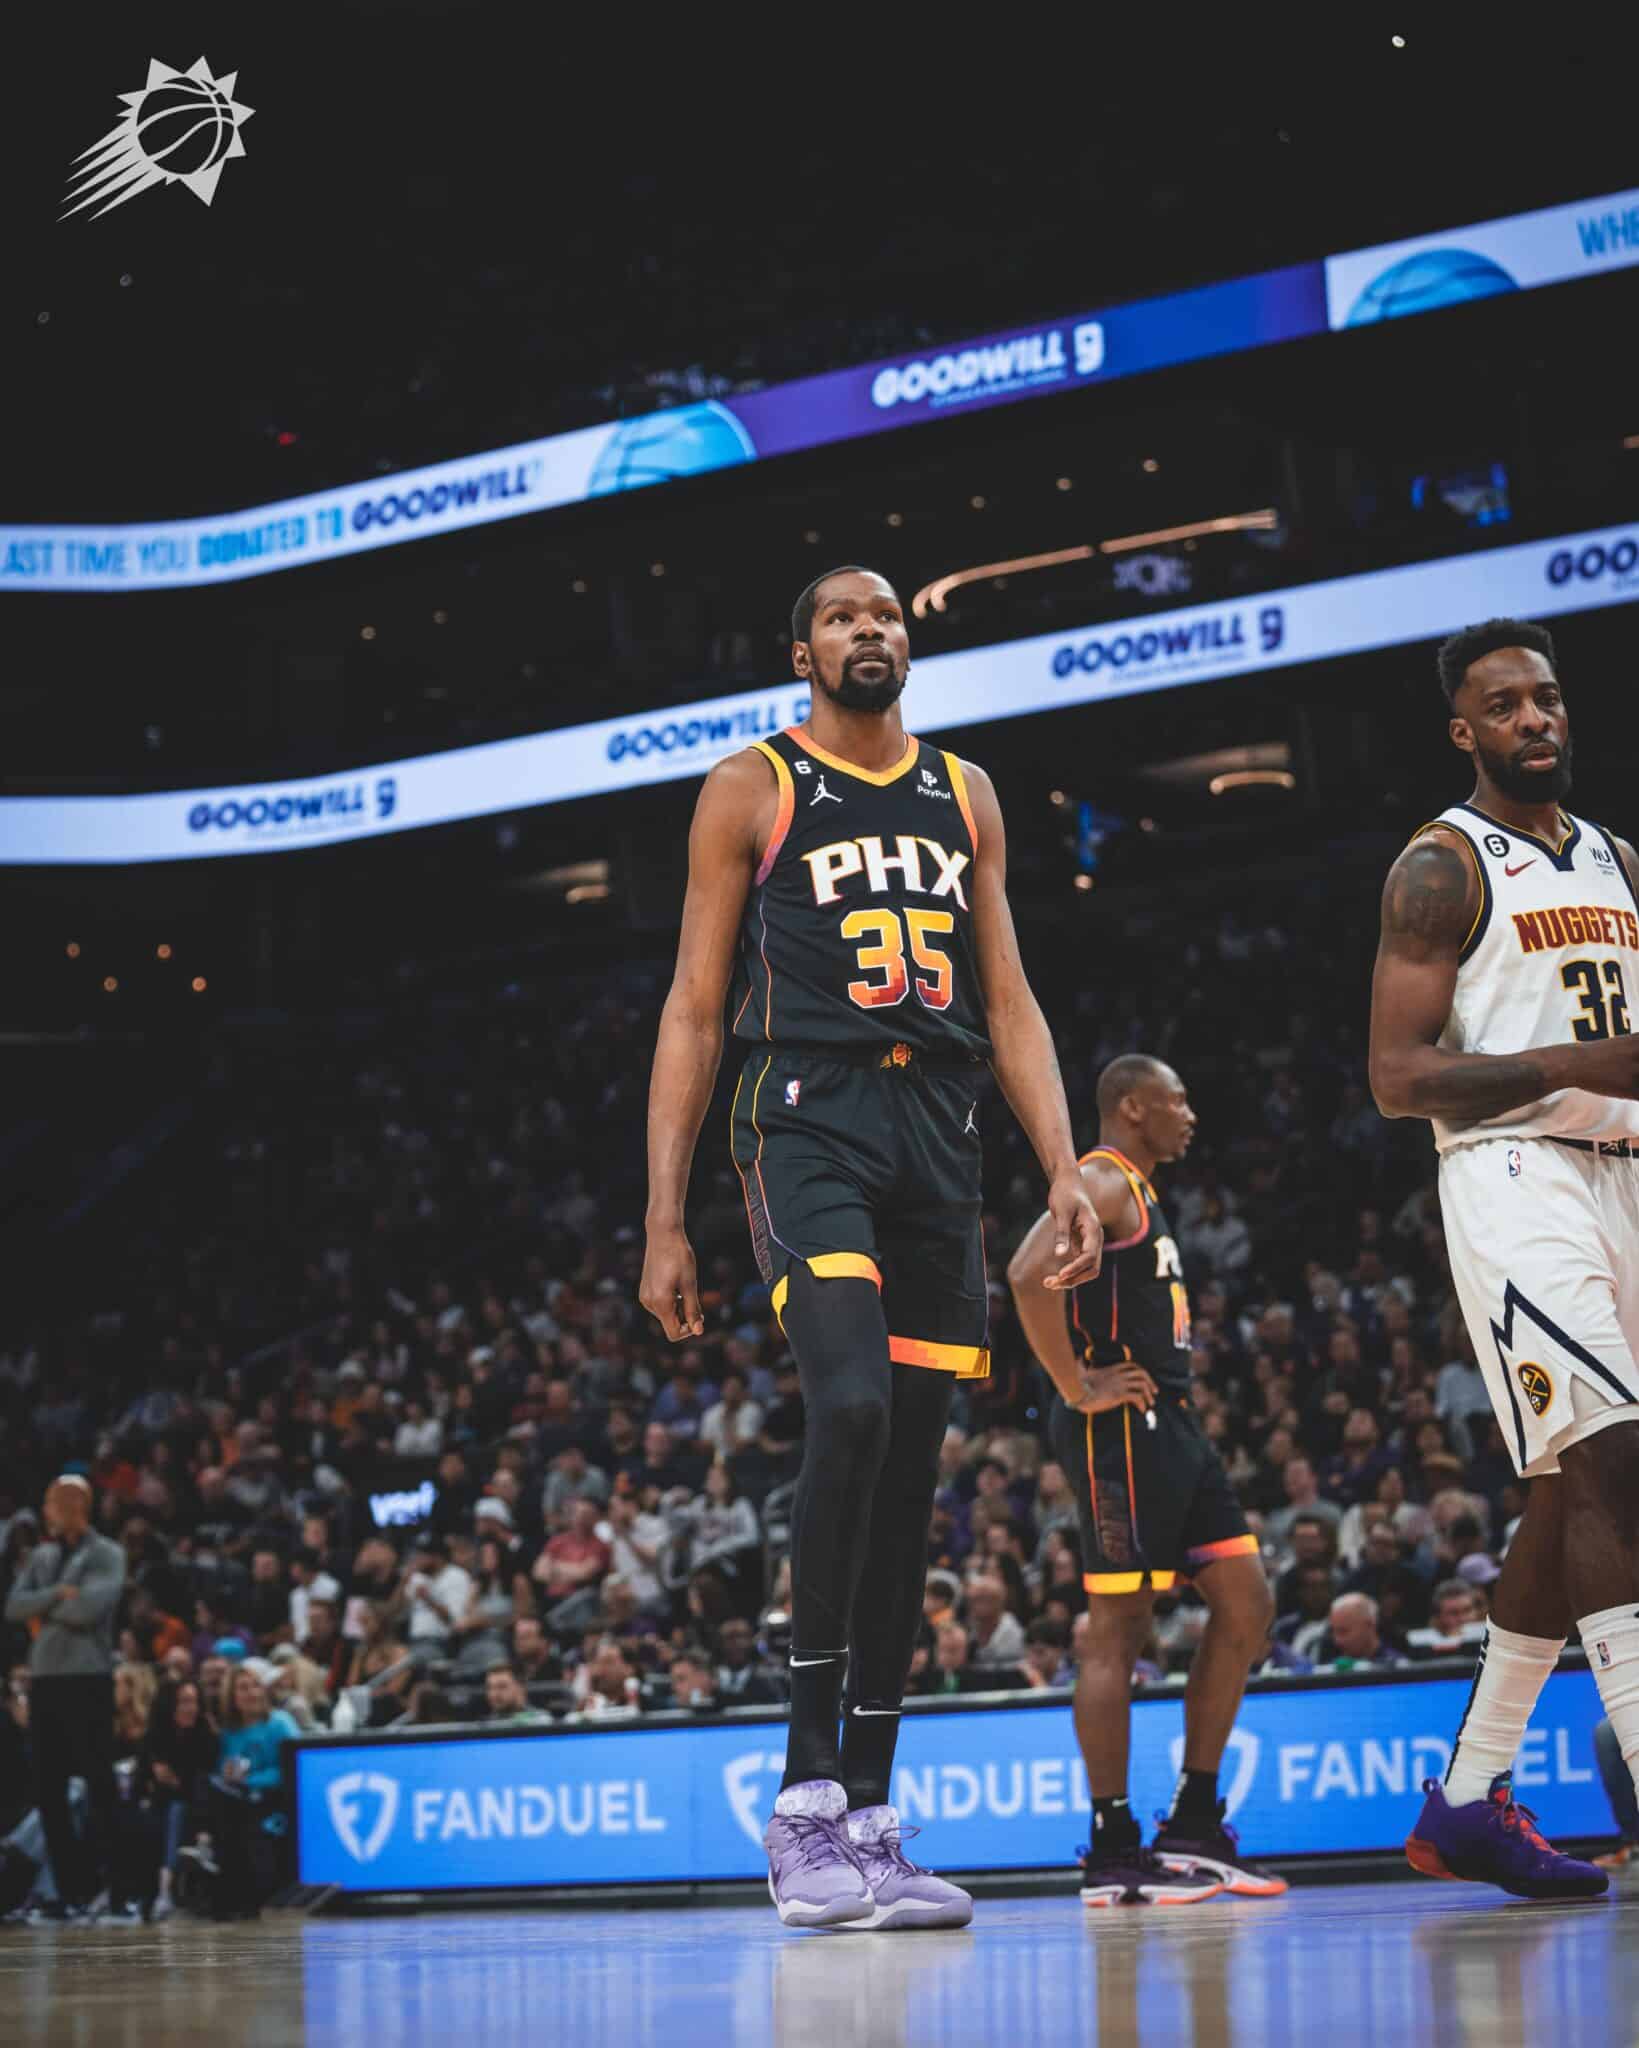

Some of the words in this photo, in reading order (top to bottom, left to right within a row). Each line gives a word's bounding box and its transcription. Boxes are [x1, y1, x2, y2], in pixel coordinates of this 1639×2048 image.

[872, 330, 1067, 408] GOODWILL
[65, 537, 127, 575] TIME
[138, 533, 189, 575] YOU
[198, 513, 308, 567] DONATED
[315, 504, 344, 540] TO
[1051, 613, 1244, 678] GOODWILL
[606, 703, 777, 763] GOODWILL
[794, 760, 812, 774] 6
[917, 784, 951, 800] PayPal
[188, 783, 363, 832] GOODWILL
[801, 836, 970, 912] PHX
[1484, 834, 1510, 858] 6
[840, 907, 955, 1011] 35
[1511, 905, 1639, 955] NUGGETS
[1559, 958, 1632, 1042] 32
[411, 1779, 667, 1842] FANDUEL
